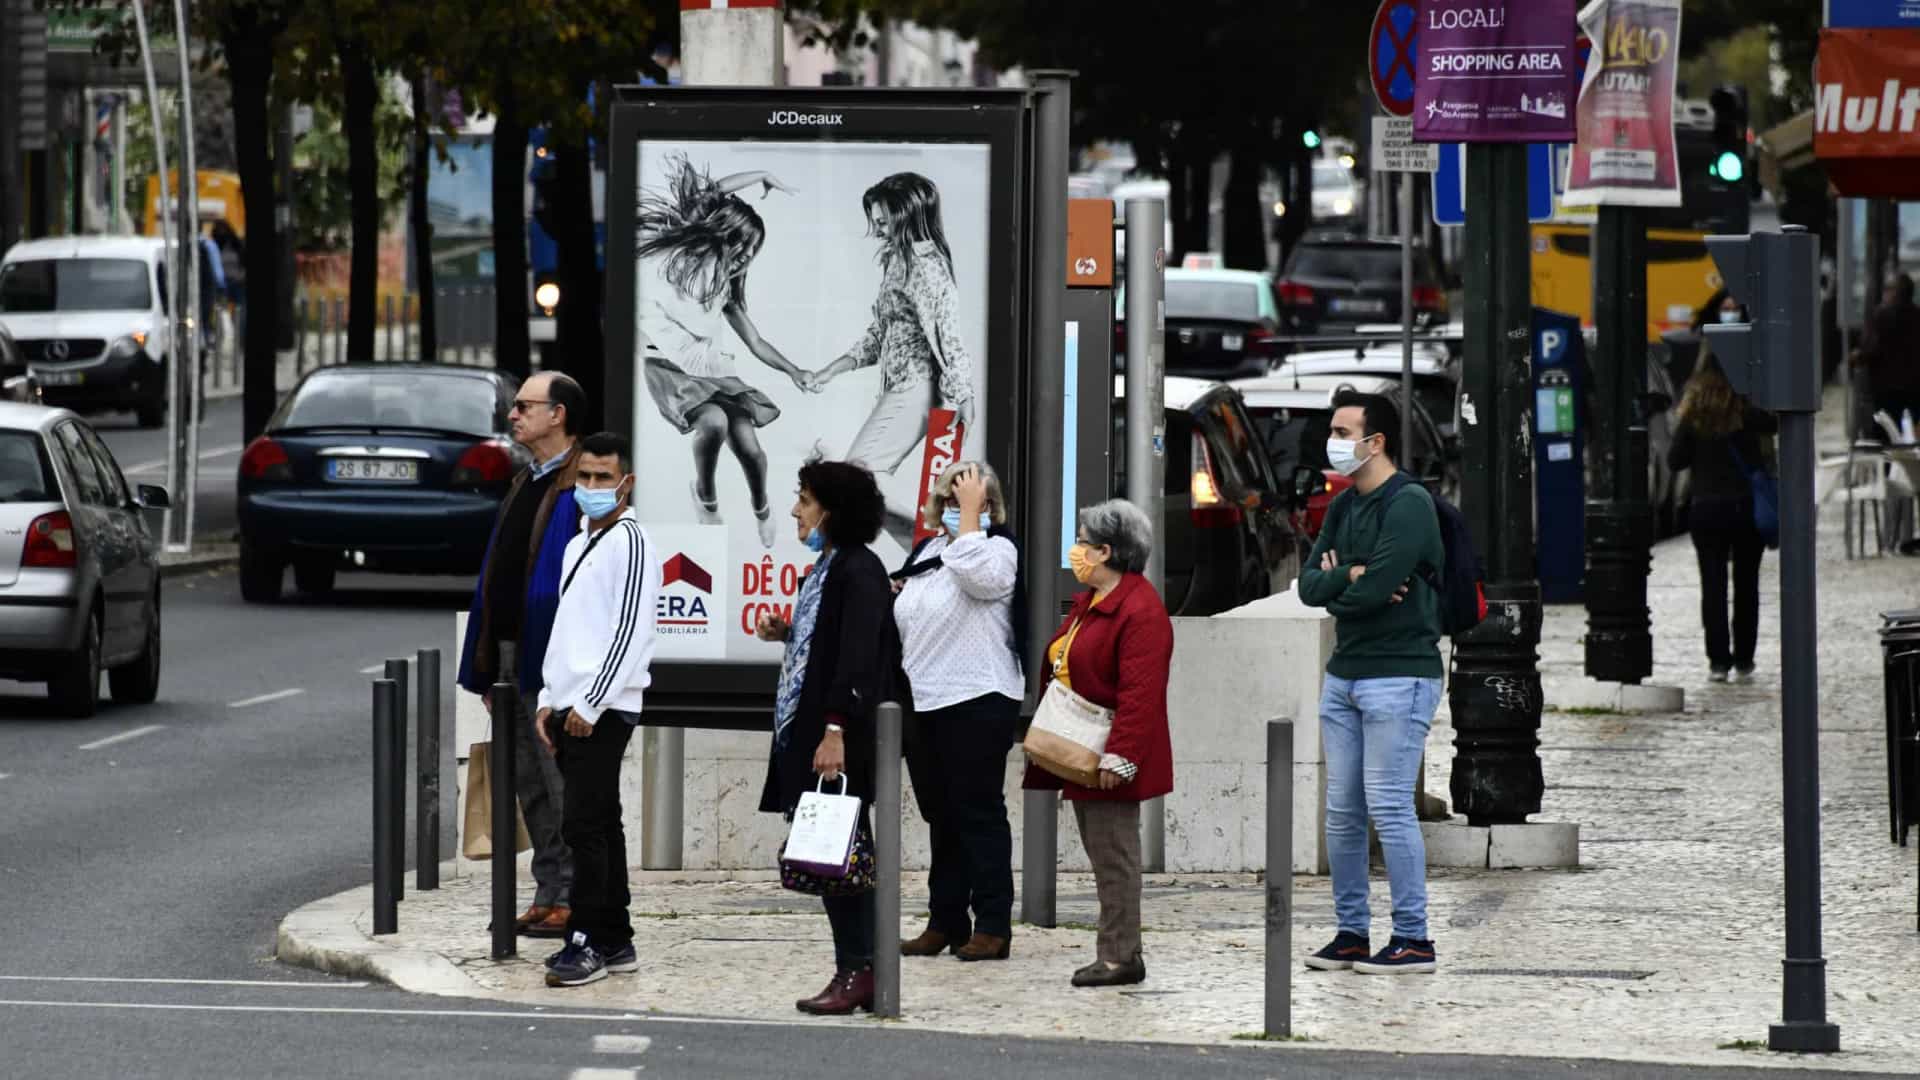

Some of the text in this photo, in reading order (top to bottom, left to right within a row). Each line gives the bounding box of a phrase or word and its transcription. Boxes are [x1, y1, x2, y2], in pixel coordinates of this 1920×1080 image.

[1429, 7, 1504, 29] LOCAL!
[1431, 53, 1562, 72] SHOPPING AREA
[767, 110, 843, 125] JCDecaux
[1542, 330, 1559, 359] P
[742, 554, 774, 596] DÊ
[780, 563, 797, 596] O
[656, 596, 708, 618] ERA
